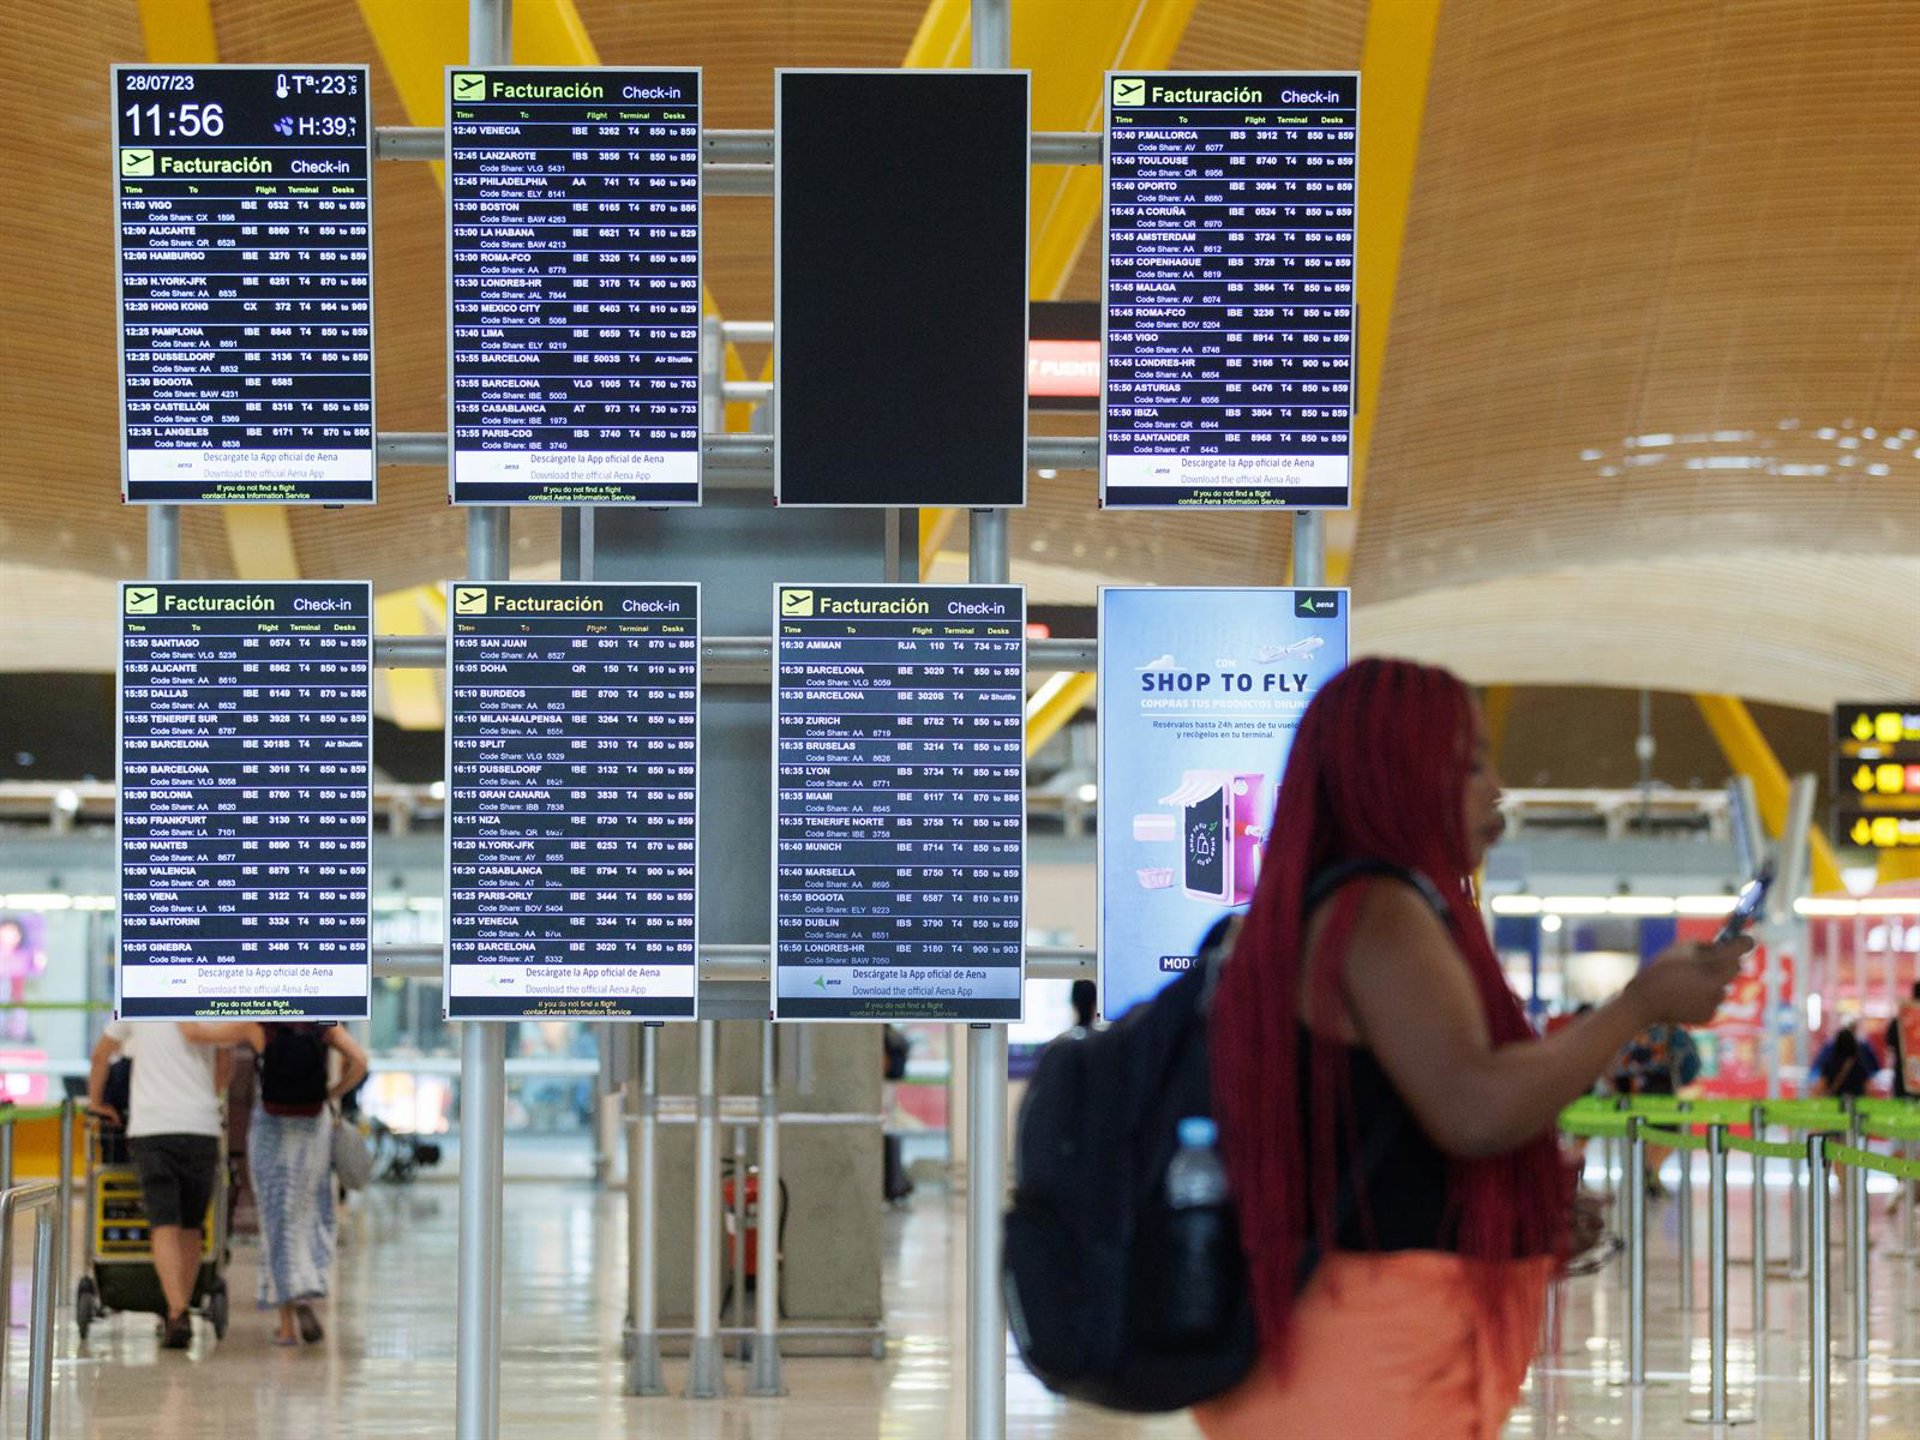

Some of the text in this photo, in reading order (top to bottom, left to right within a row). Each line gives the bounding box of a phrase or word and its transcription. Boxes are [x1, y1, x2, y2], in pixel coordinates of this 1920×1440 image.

[127, 76, 195, 91] 28/07/23
[493, 83, 681, 99] Facturación Check-in
[1153, 87, 1339, 103] Facturación Check-in
[126, 104, 224, 137] 11:56
[453, 126, 477, 135] 12:40
[479, 127, 521, 135] VENECIA
[572, 127, 588, 135] IBE
[628, 127, 640, 135] T4
[650, 128, 666, 136] 850
[681, 128, 696, 136] 859
[161, 157, 350, 173] Facturación Check-in
[454, 177, 548, 186] 12:45 PHILADELPHIA
[1112, 182, 1135, 190] 15:40
[1137, 182, 1177, 190] OPORTO
[1230, 182, 1245, 191] IBE
[454, 203, 519, 211] 13:00 BOSTON
[123, 227, 196, 235] 12:00 ALICANTE
[1111, 258, 1202, 266] 15:45 COPENHAGUE
[125, 303, 149, 311] 12:20
[151, 303, 179, 311] HONG
[181, 303, 209, 311] KONG
[244, 302, 257, 311] CX
[275, 302, 291, 311] 372
[299, 302, 311, 311] T4
[321, 303, 337, 311] 964
[351, 303, 368, 311] 969
[126, 328, 204, 336] 12:25 PAMPLONA
[455, 329, 479, 337] 13:40
[481, 329, 504, 337] LIMA
[574, 330, 589, 338] IBE
[1109, 333, 1133, 342] 15:45
[1135, 333, 1159, 342] VIGO
[1227, 334, 1243, 342] IBE
[1282, 334, 1293, 342] T4
[1303, 334, 1319, 342] 850
[1334, 334, 1350, 342] 859
[127, 378, 193, 386] 12:30 BOGOTA
[128, 402, 210, 411] 12:30 CASTELLÓN
[1109, 409, 1159, 417] 15:50 IBIZA
[1108, 434, 1190, 442] 15:50 SANTANDER
[165, 595, 352, 611] Facturación Check-in
[495, 596, 680, 612] Facturación Check-in
[821, 598, 1005, 615] Facturación Check-in
[125, 639, 149, 648] 15:50
[151, 639, 200, 648] SANTIAGO
[243, 639, 259, 647] IBE
[299, 639, 311, 647] T4
[320, 639, 337, 647] 850
[351, 639, 367, 647] 859
[455, 639, 527, 648] 16:05 SAN JUAN
[1215, 659, 1236, 668] CON
[455, 664, 478, 672] 16:05
[481, 664, 508, 672] DOHA
[572, 665, 586, 673] QR
[604, 665, 619, 673] 150
[649, 666, 665, 674] 910
[679, 666, 695, 674] 919
[1142, 673, 1308, 692] SHOP TO FLY
[125, 690, 189, 698] 15:55 DALLAS
[1141, 699, 1188, 708] COMPRAS
[1191, 699, 1210, 708] TUS
[1212, 700, 1272, 709] PRODUCTOS
[1153, 720, 1193, 729] Resérvalos
[1195, 720, 1216, 729] hasta
[1218, 721, 1232, 729] 24h
[1234, 721, 1255, 729] antes
[1256, 721, 1266, 729] de
[1232, 731, 1240, 739] tu
[454, 740, 506, 748] 16:10 SPLIT
[780, 767, 804, 775] 16:35
[806, 767, 831, 776] LYON
[897, 768, 913, 776] IBS
[952, 768, 964, 776] T4
[972, 768, 990, 777] 850
[1004, 769, 1020, 777] 859
[124, 816, 148, 825] 16:00
[150, 816, 207, 825] FRANKFURT
[243, 816, 259, 824] IBE
[453, 841, 535, 850] 16:20 N.YORK-JFK
[124, 892, 179, 901] 16:00 VIENA
[452, 892, 533, 900] 16:25 PARIS-ORLY
[779, 893, 845, 902] 16:50 BOGOTA
[124, 918, 200, 926] 16:00 SANTORINI
[779, 919, 839, 927] 16:50 DUBLIN
[1163, 958, 1189, 969] MOD
[853, 969, 986, 980] Descárgate la App oficial de Aena
[853, 986, 972, 997] Download the official Aena App
